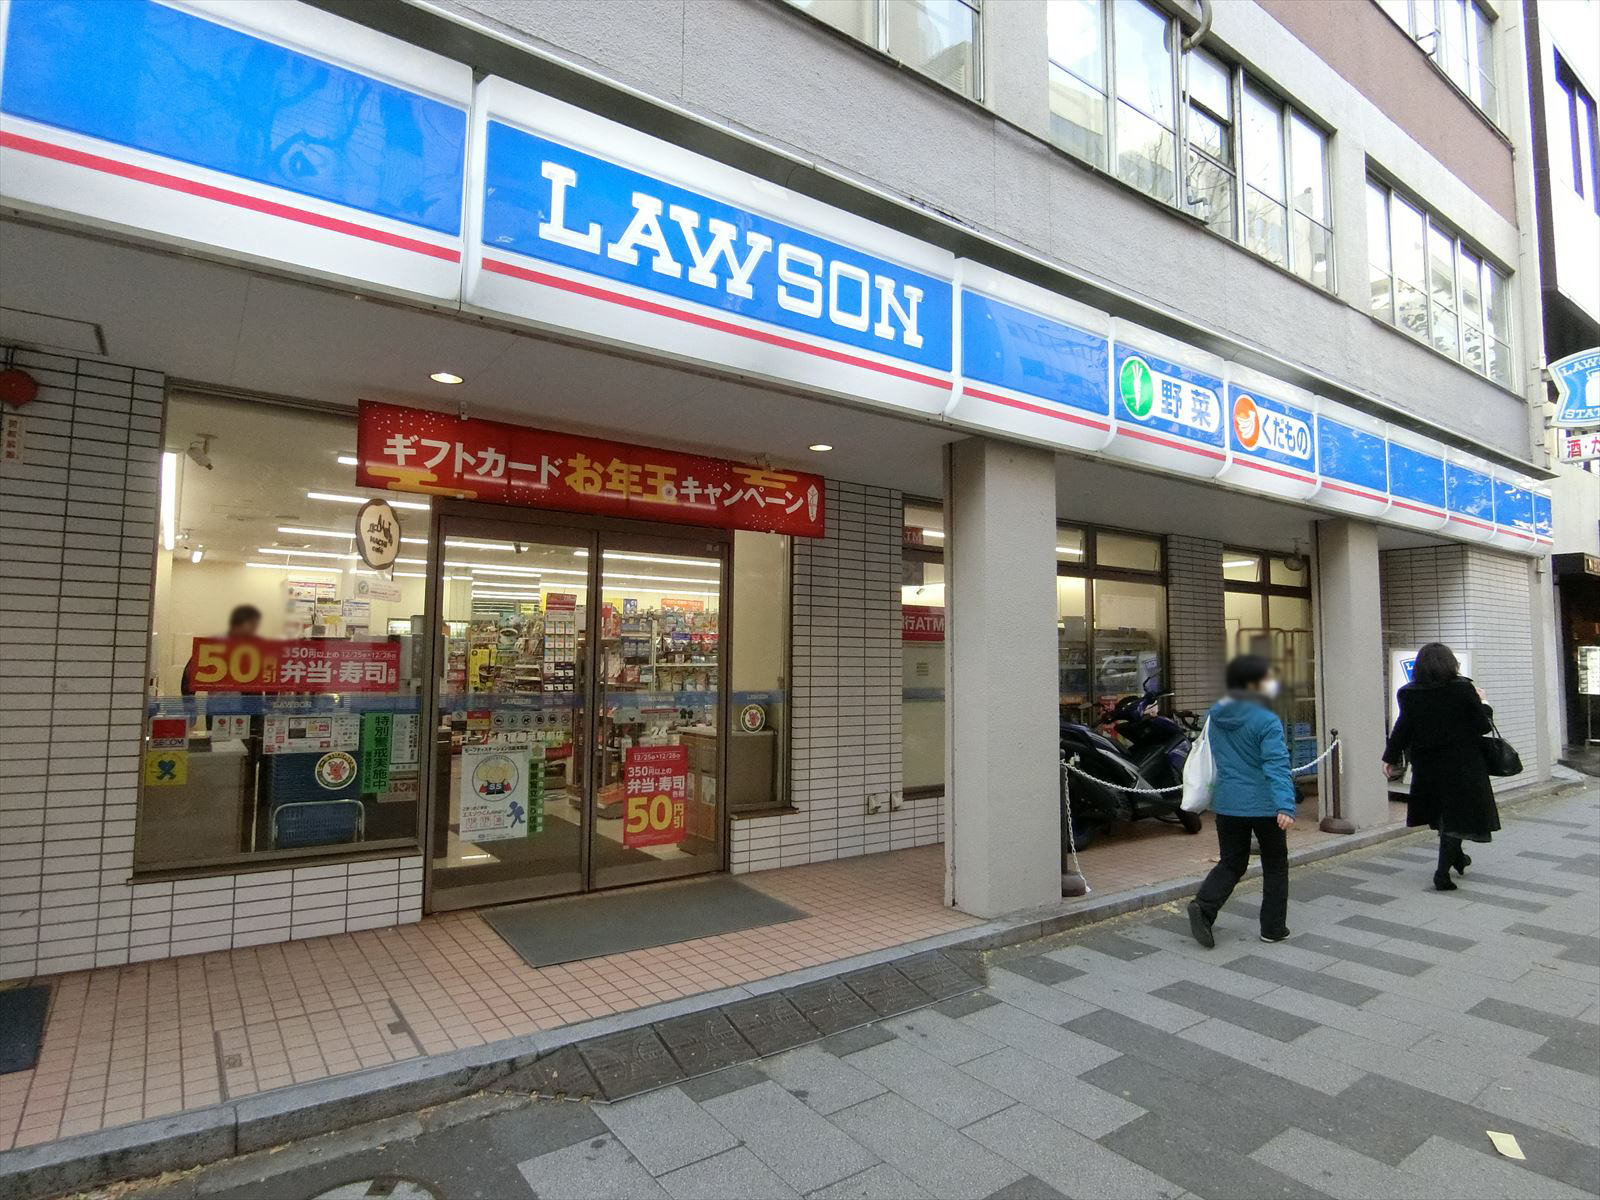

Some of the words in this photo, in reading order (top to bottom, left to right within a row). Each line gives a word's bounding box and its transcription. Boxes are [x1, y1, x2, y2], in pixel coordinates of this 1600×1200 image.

[538, 160, 923, 349] LAWSON
[1161, 379, 1212, 428] 野菜
[1565, 408, 1600, 419] STA
[1261, 414, 1308, 456] くだもの
[902, 615, 945, 632] 行ATM
[627, 775, 685, 794] 弁当・寿司
